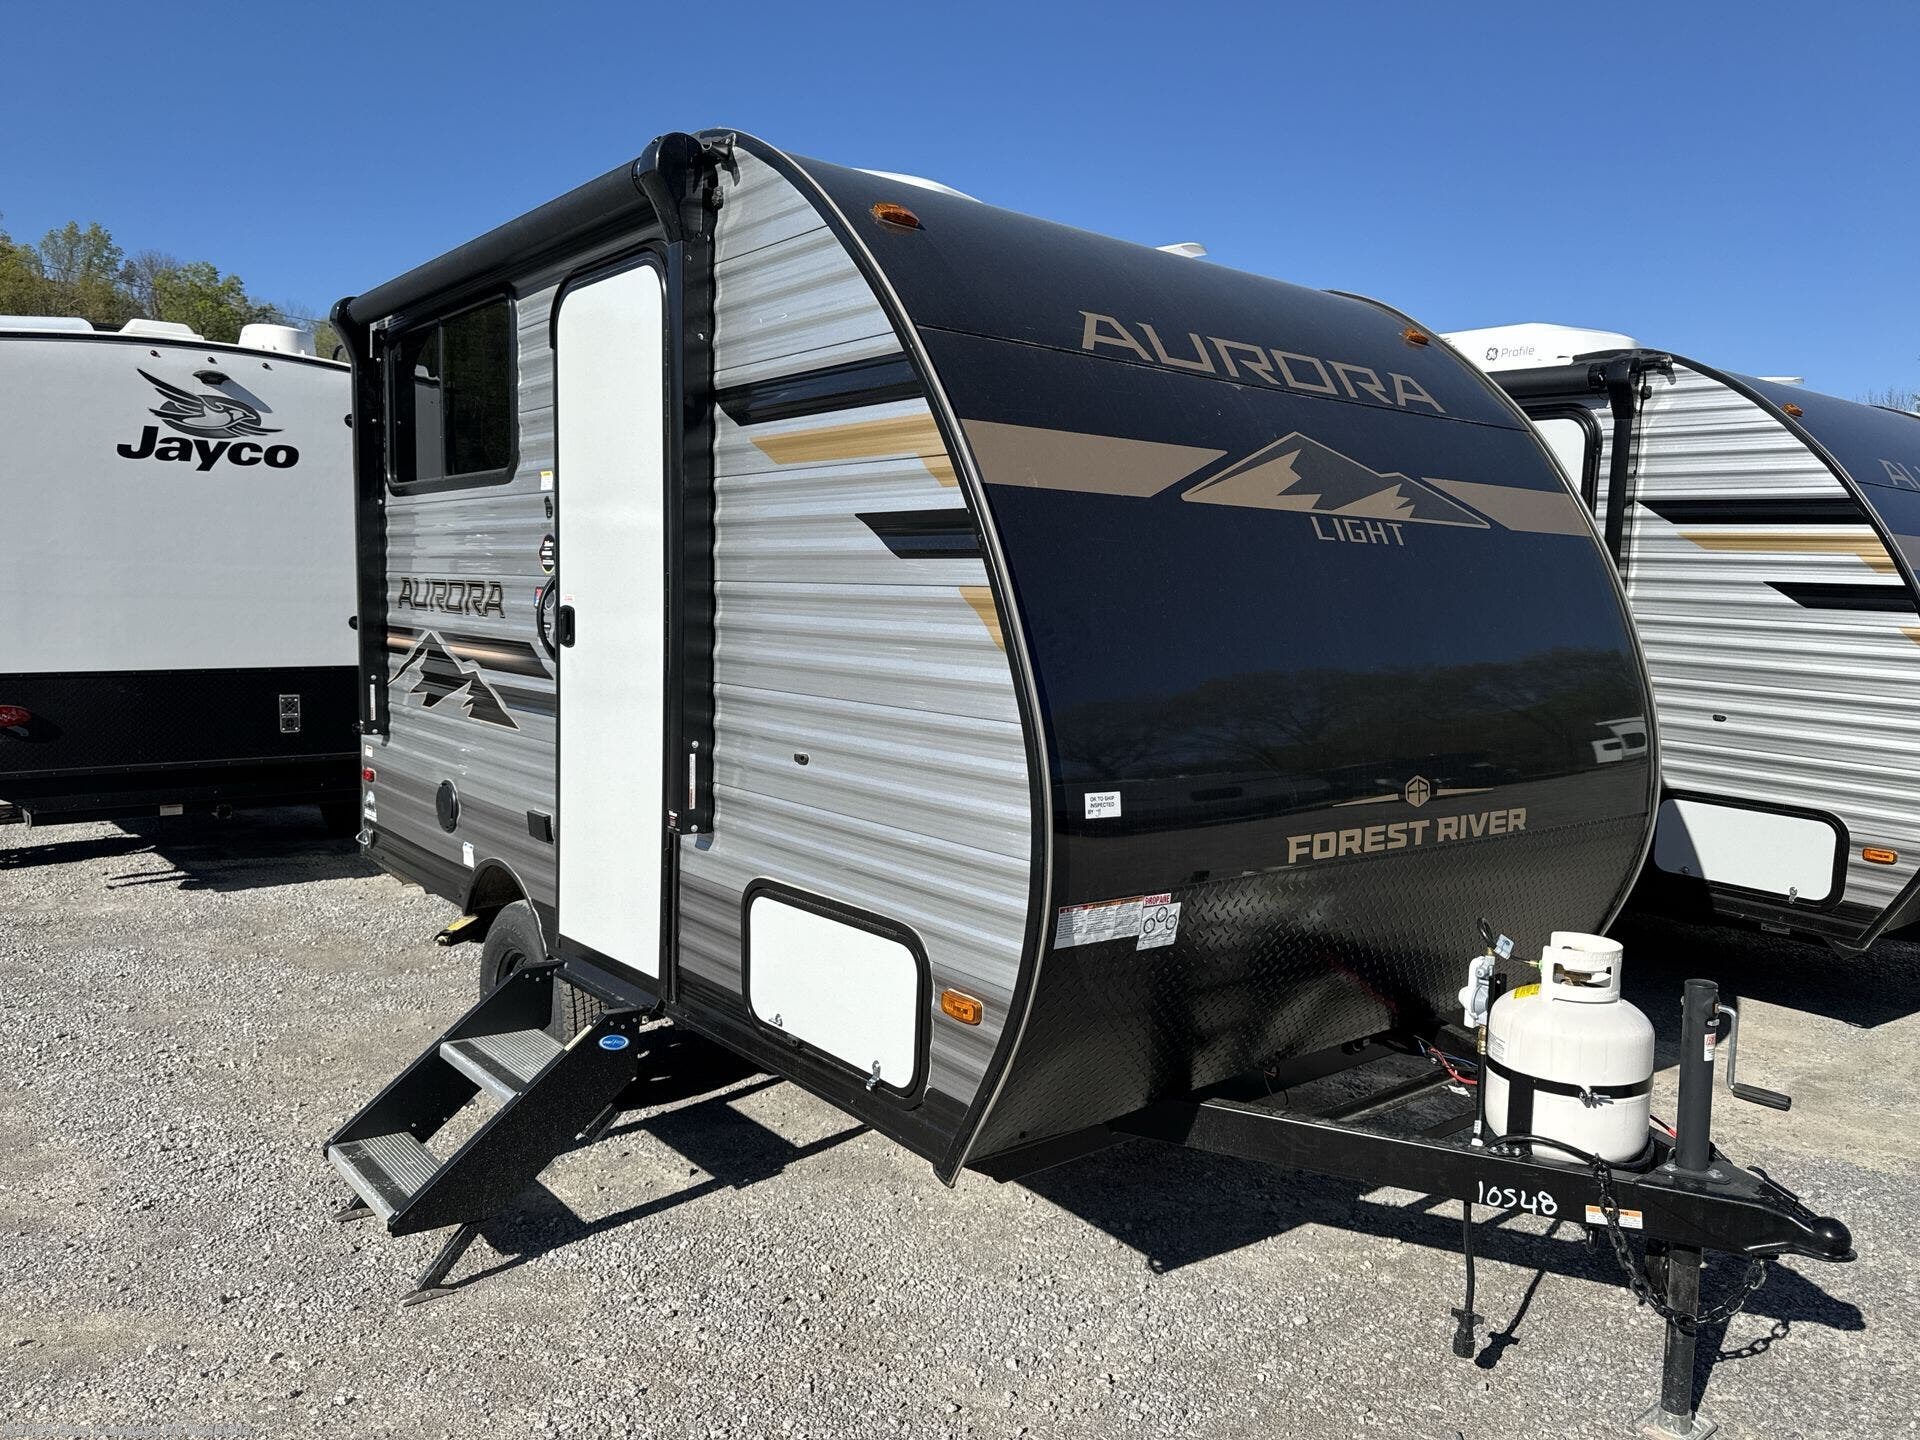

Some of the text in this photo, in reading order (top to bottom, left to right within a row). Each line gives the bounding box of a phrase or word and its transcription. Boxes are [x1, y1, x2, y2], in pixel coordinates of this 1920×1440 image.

[1079, 310, 1446, 414] AURORA
[1501, 345, 1535, 358] Profile
[117, 425, 300, 472] Jayco
[1310, 516, 1405, 546] LIGHT
[398, 577, 506, 619] AURORA
[1286, 807, 1527, 865] FOREST RIVER
[1144, 894, 1171, 905] PROPANE
[1477, 1180, 1558, 1216] 10548
